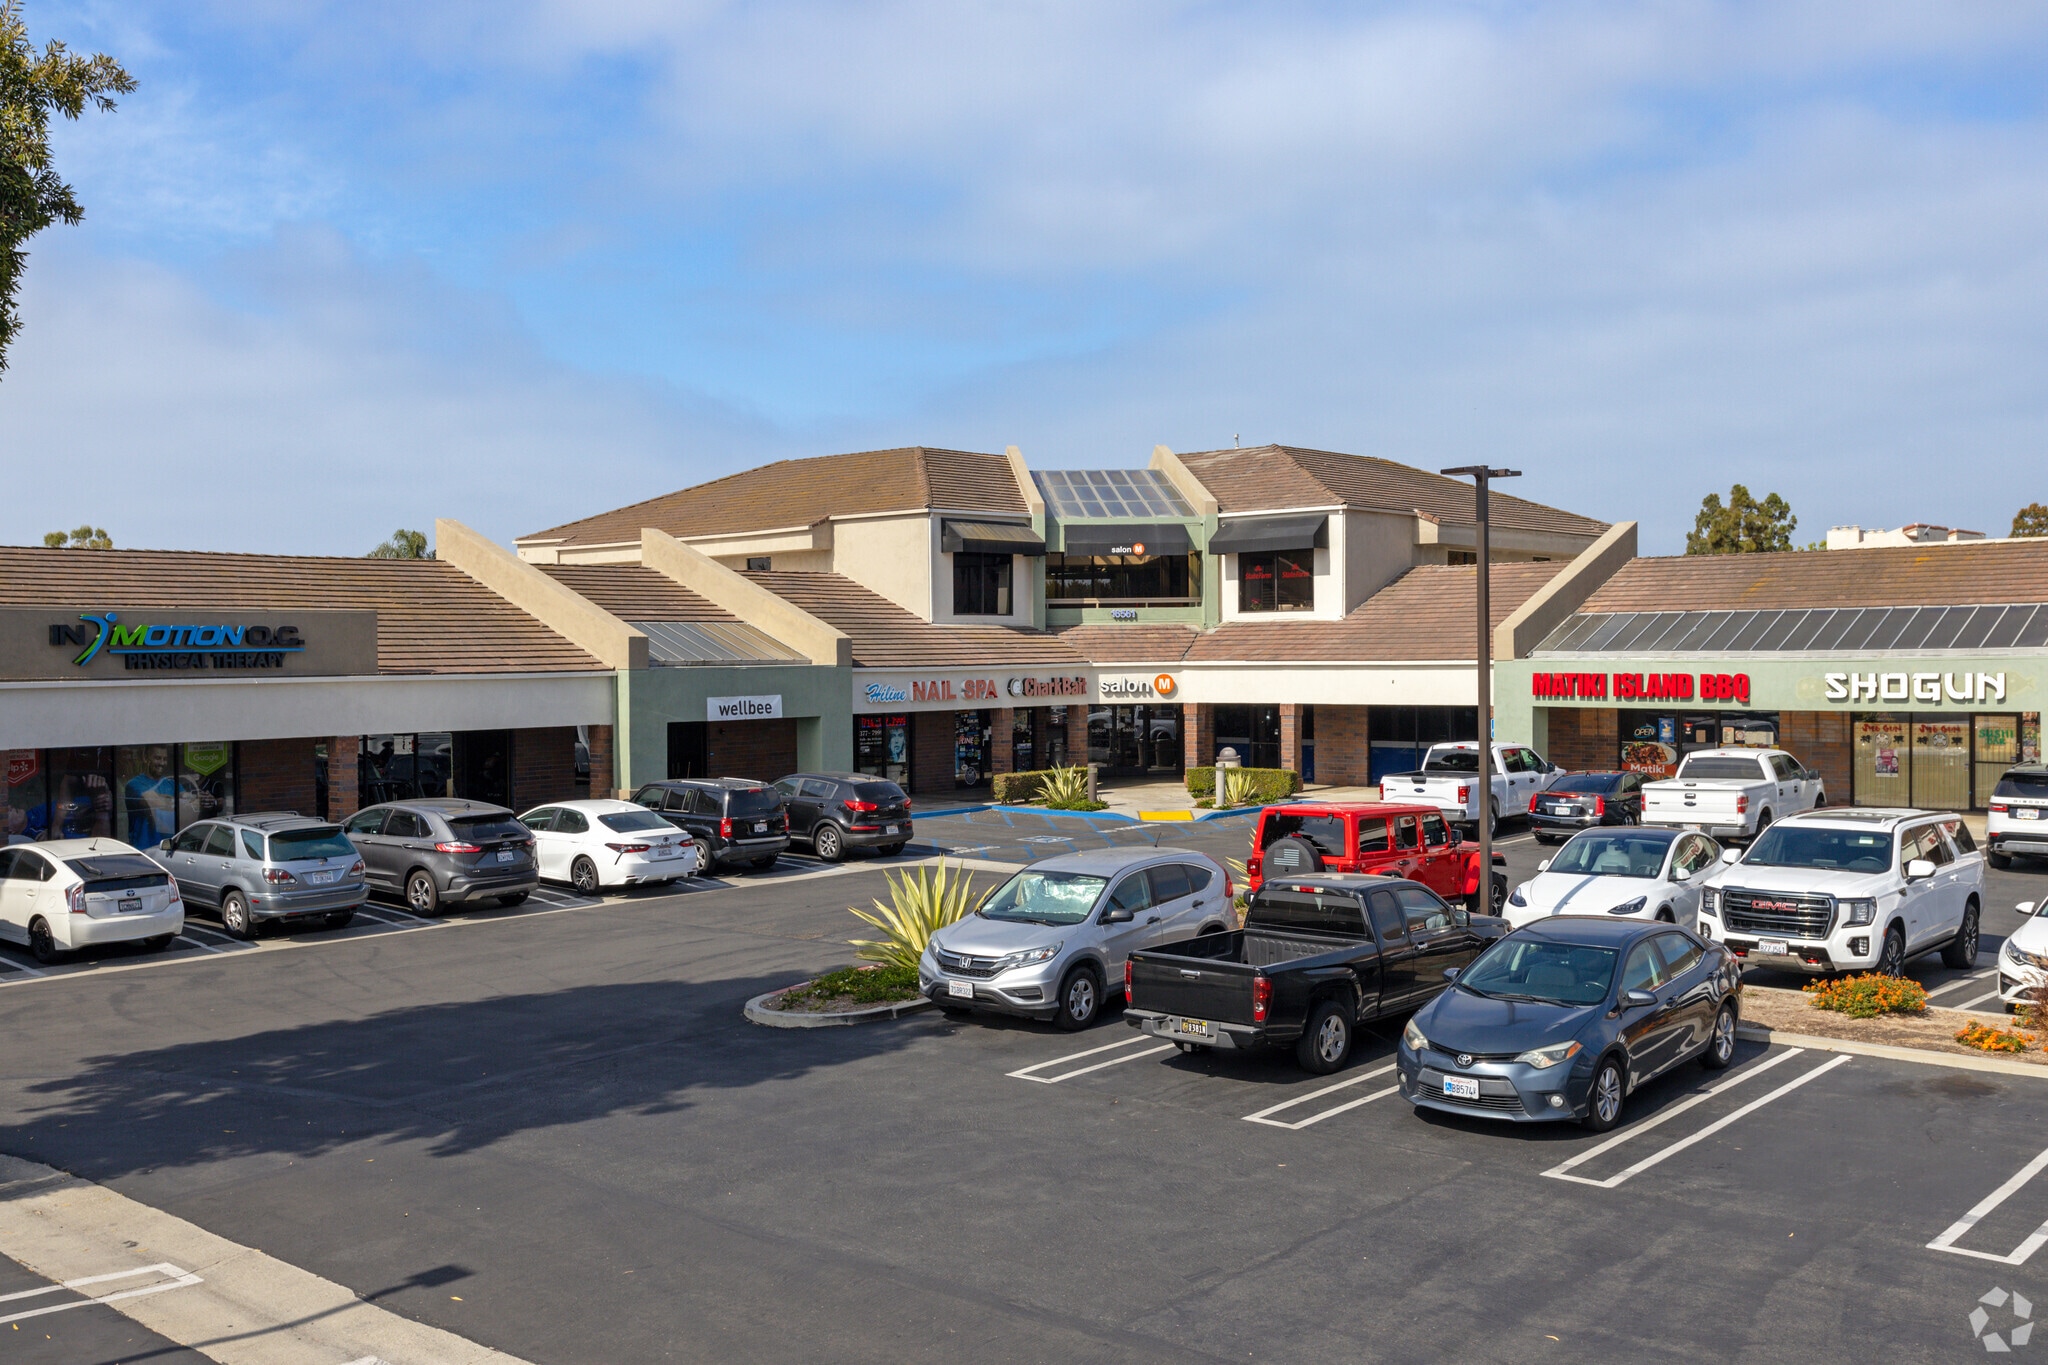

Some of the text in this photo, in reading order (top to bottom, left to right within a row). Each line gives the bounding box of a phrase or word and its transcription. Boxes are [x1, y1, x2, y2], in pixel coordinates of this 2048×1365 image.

[1111, 545, 1143, 553] salon M
[49, 624, 305, 646] IN MOTION O.C.
[125, 652, 286, 669] PHYSICAL THERAPY
[864, 679, 998, 703] Hiline NAIL SPA
[1100, 677, 1171, 693] salon M
[1532, 673, 1750, 703] MATIKI ISLAND BBQ
[1824, 672, 2007, 702] SHOGUN
[718, 700, 773, 716] wellbee
[1633, 726, 1655, 737] OPEN
[1979, 729, 2014, 738] SUSHI
[1630, 763, 1665, 774] Matiki
[1752, 900, 1797, 911] GMC
